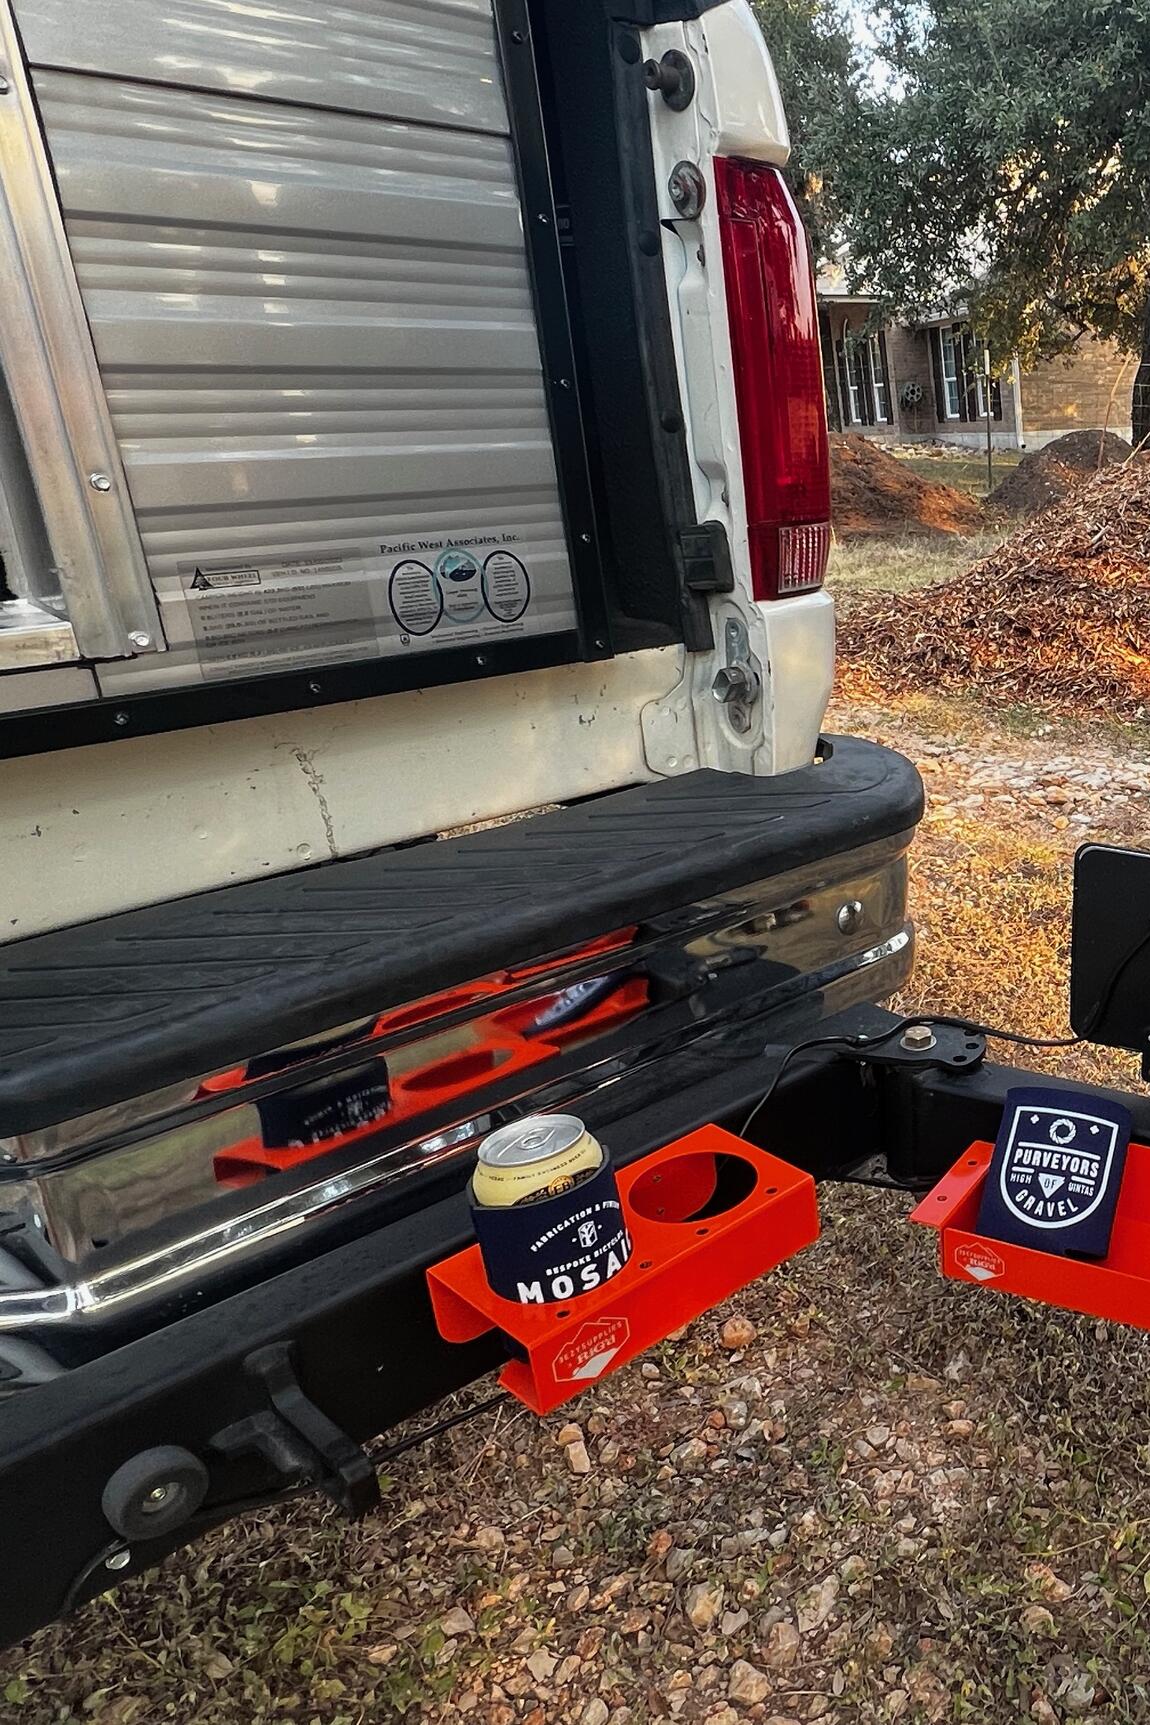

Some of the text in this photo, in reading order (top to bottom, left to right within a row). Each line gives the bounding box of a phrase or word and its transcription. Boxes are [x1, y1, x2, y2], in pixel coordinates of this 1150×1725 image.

[380, 533, 521, 554] Pacific West Associates, Inc.
[1013, 1148, 1101, 1178] PURVEYORS
[1009, 1172, 1033, 1185] HIGH
[1043, 1178, 1057, 1190] OF
[1015, 1188, 1079, 1217] GRAVEL
[530, 1207, 593, 1252] FABRICATION
[546, 1254, 592, 1276] BESPOKE
